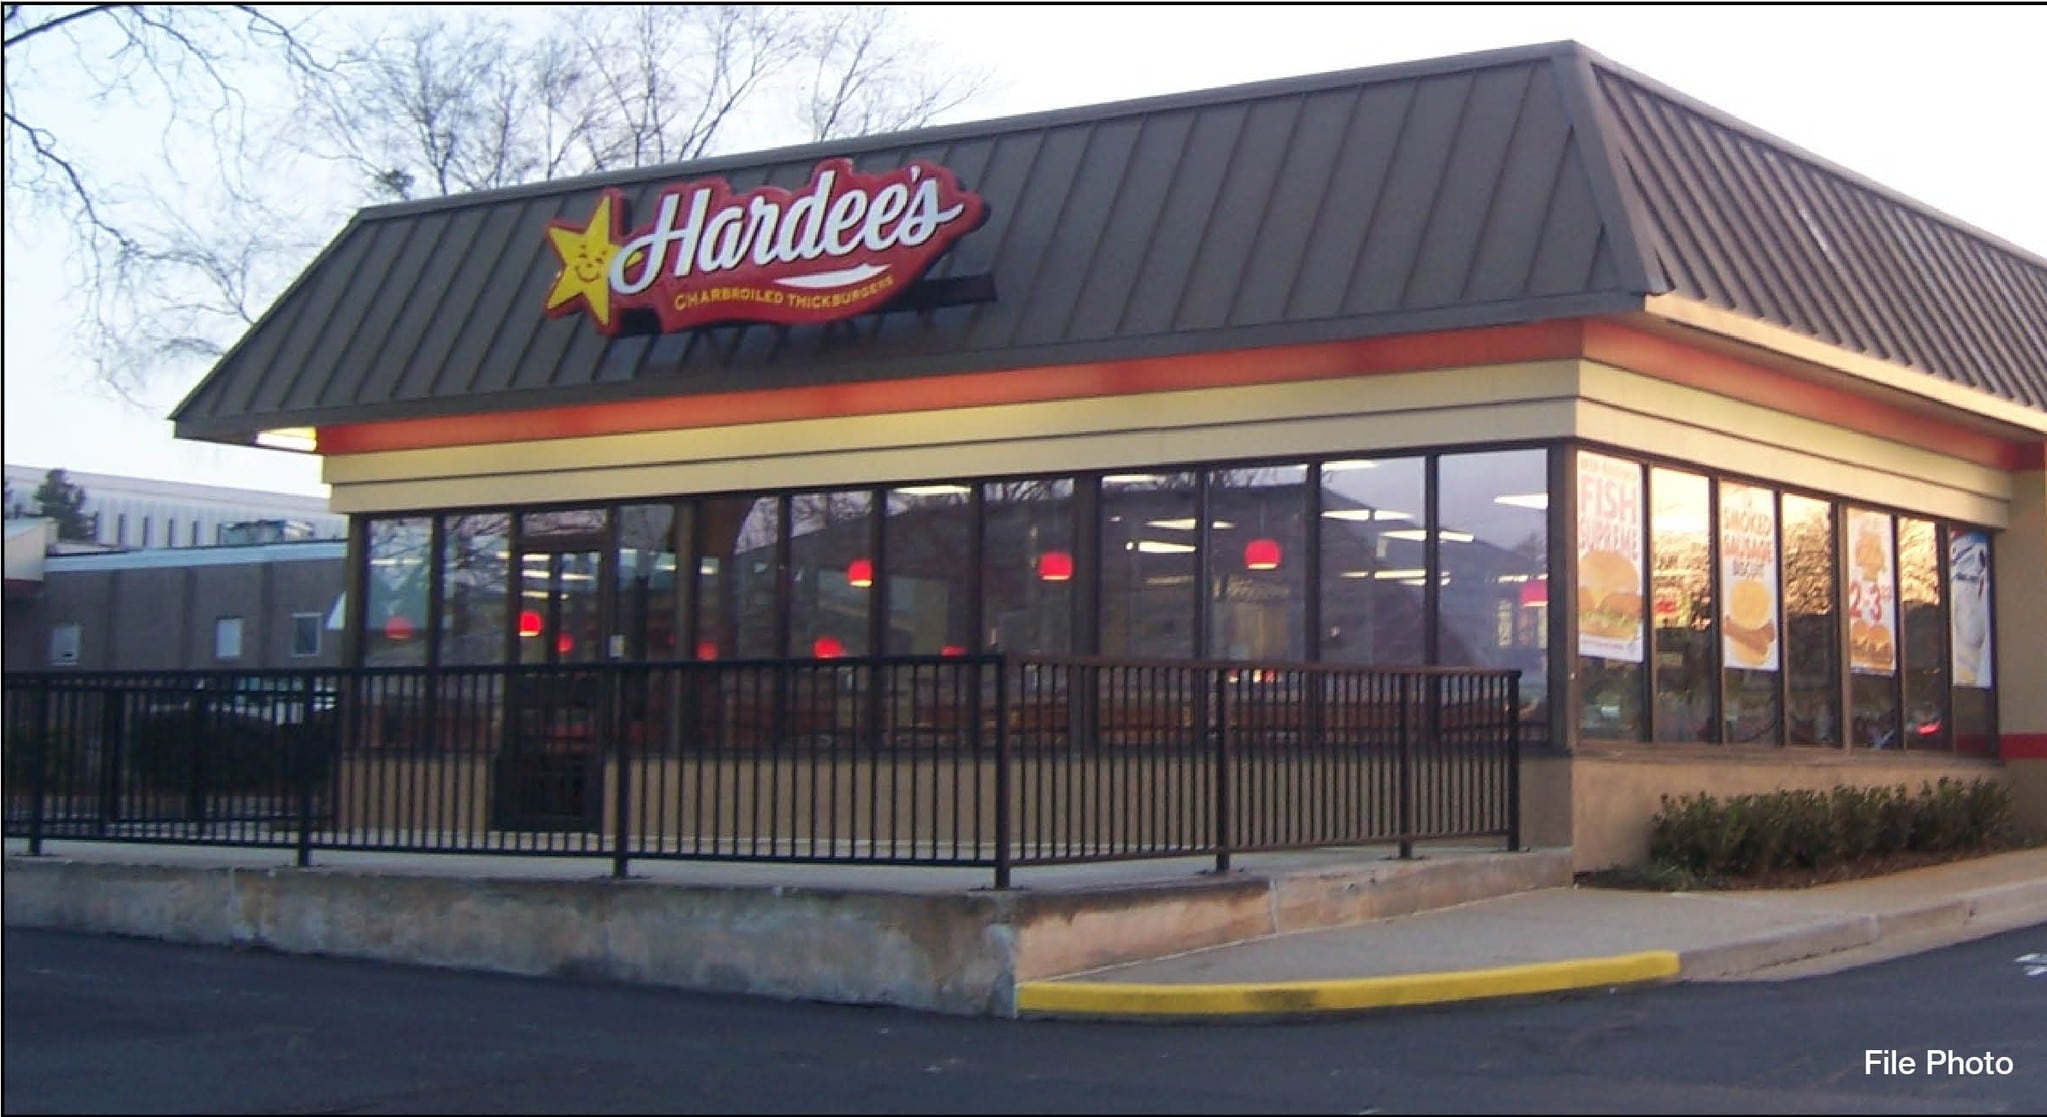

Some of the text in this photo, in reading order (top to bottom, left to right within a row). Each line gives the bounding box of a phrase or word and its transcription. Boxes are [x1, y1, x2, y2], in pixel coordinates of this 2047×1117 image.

[608, 165, 964, 295] Hardee's
[674, 275, 895, 311] CHARBROILED THICKBURGERS
[1580, 473, 1638, 524] FISH
